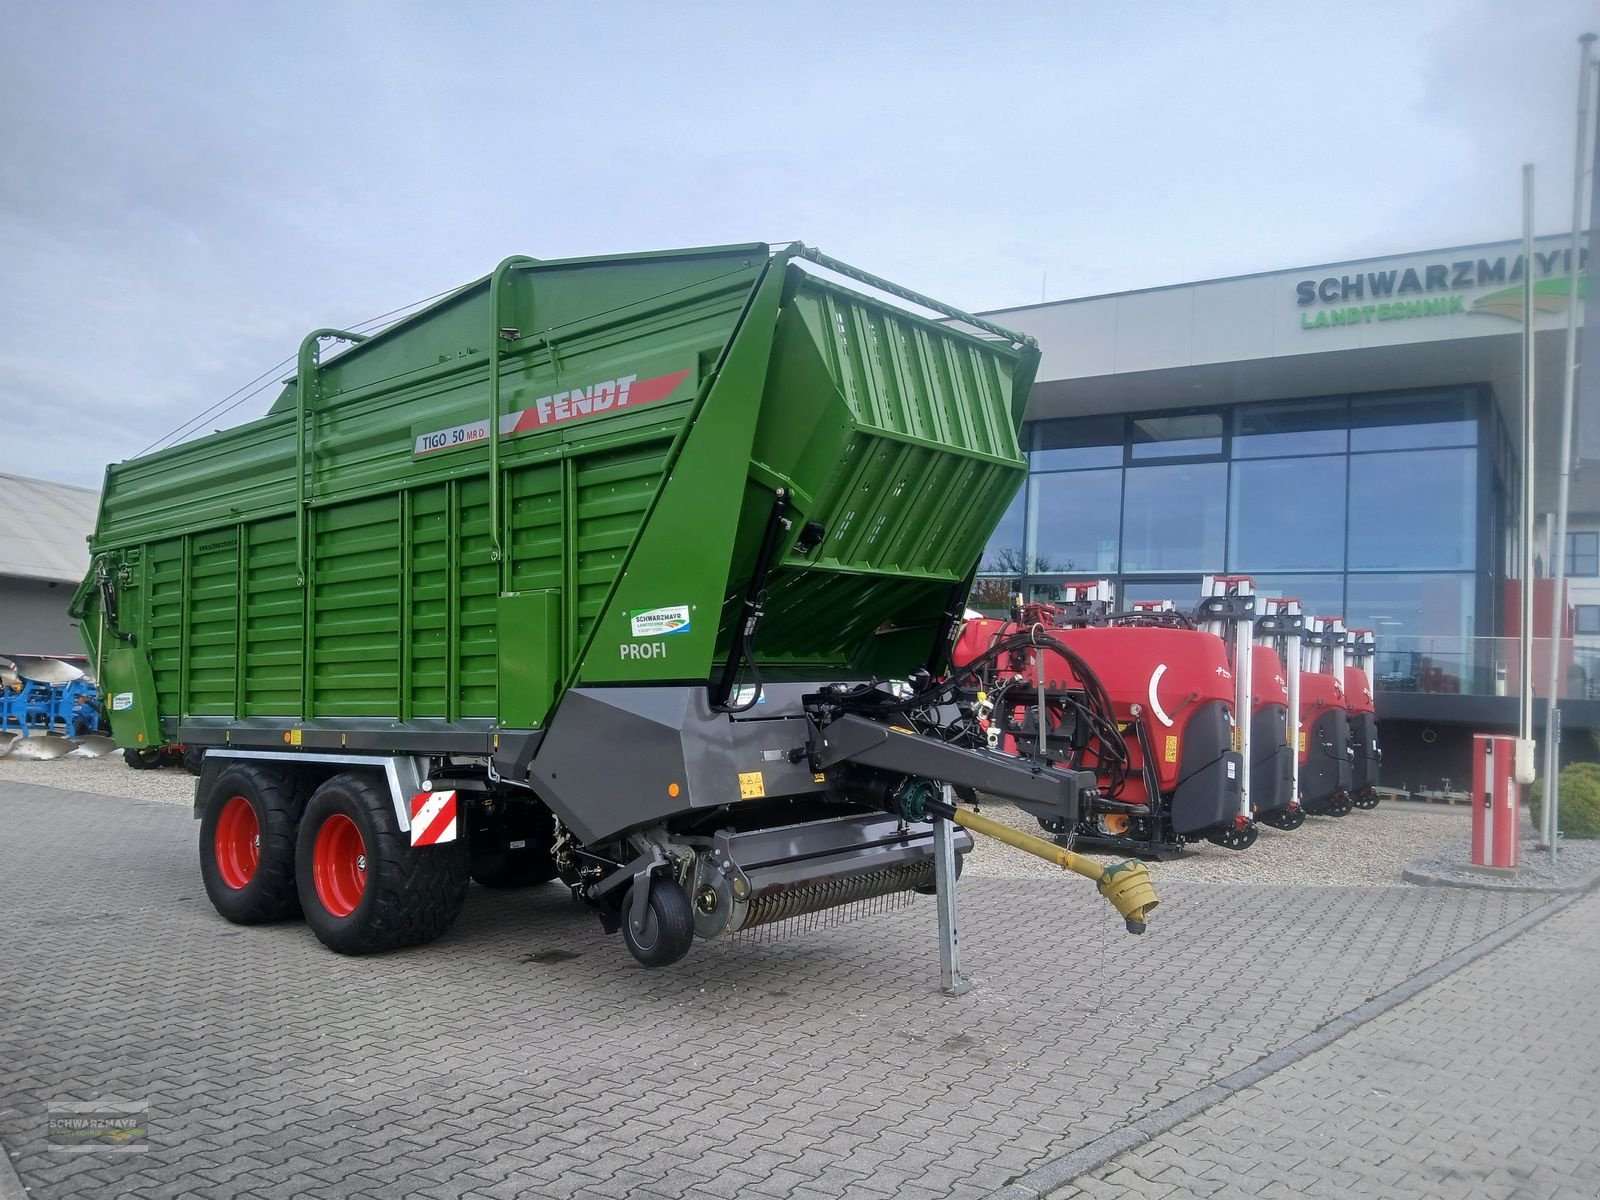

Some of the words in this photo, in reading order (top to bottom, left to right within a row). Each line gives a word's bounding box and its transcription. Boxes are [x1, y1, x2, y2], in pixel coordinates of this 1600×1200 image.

[1301, 294, 1466, 330] LANDTECHNIK
[535, 373, 638, 425] FENDT
[423, 433, 447, 450] TIGO
[452, 429, 465, 443] 50
[636, 613, 682, 623] SCHWARZMAYR
[620, 642, 667, 660] PROFI
